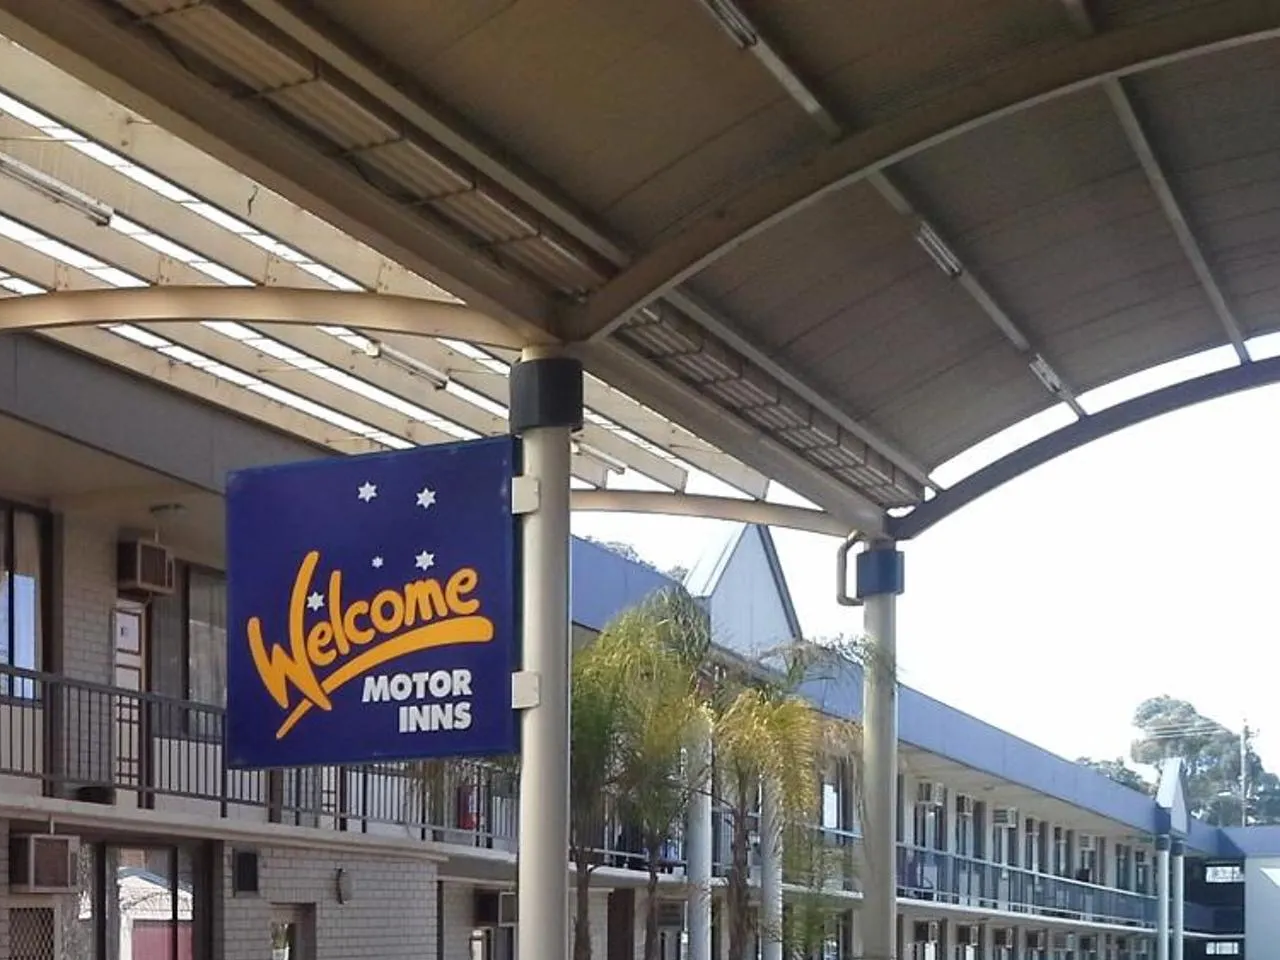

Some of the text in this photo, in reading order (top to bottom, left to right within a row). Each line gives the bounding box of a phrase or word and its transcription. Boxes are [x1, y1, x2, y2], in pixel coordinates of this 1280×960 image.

[247, 551, 480, 711] Welcome
[362, 669, 472, 702] MOTOR
[399, 702, 472, 733] INNS
